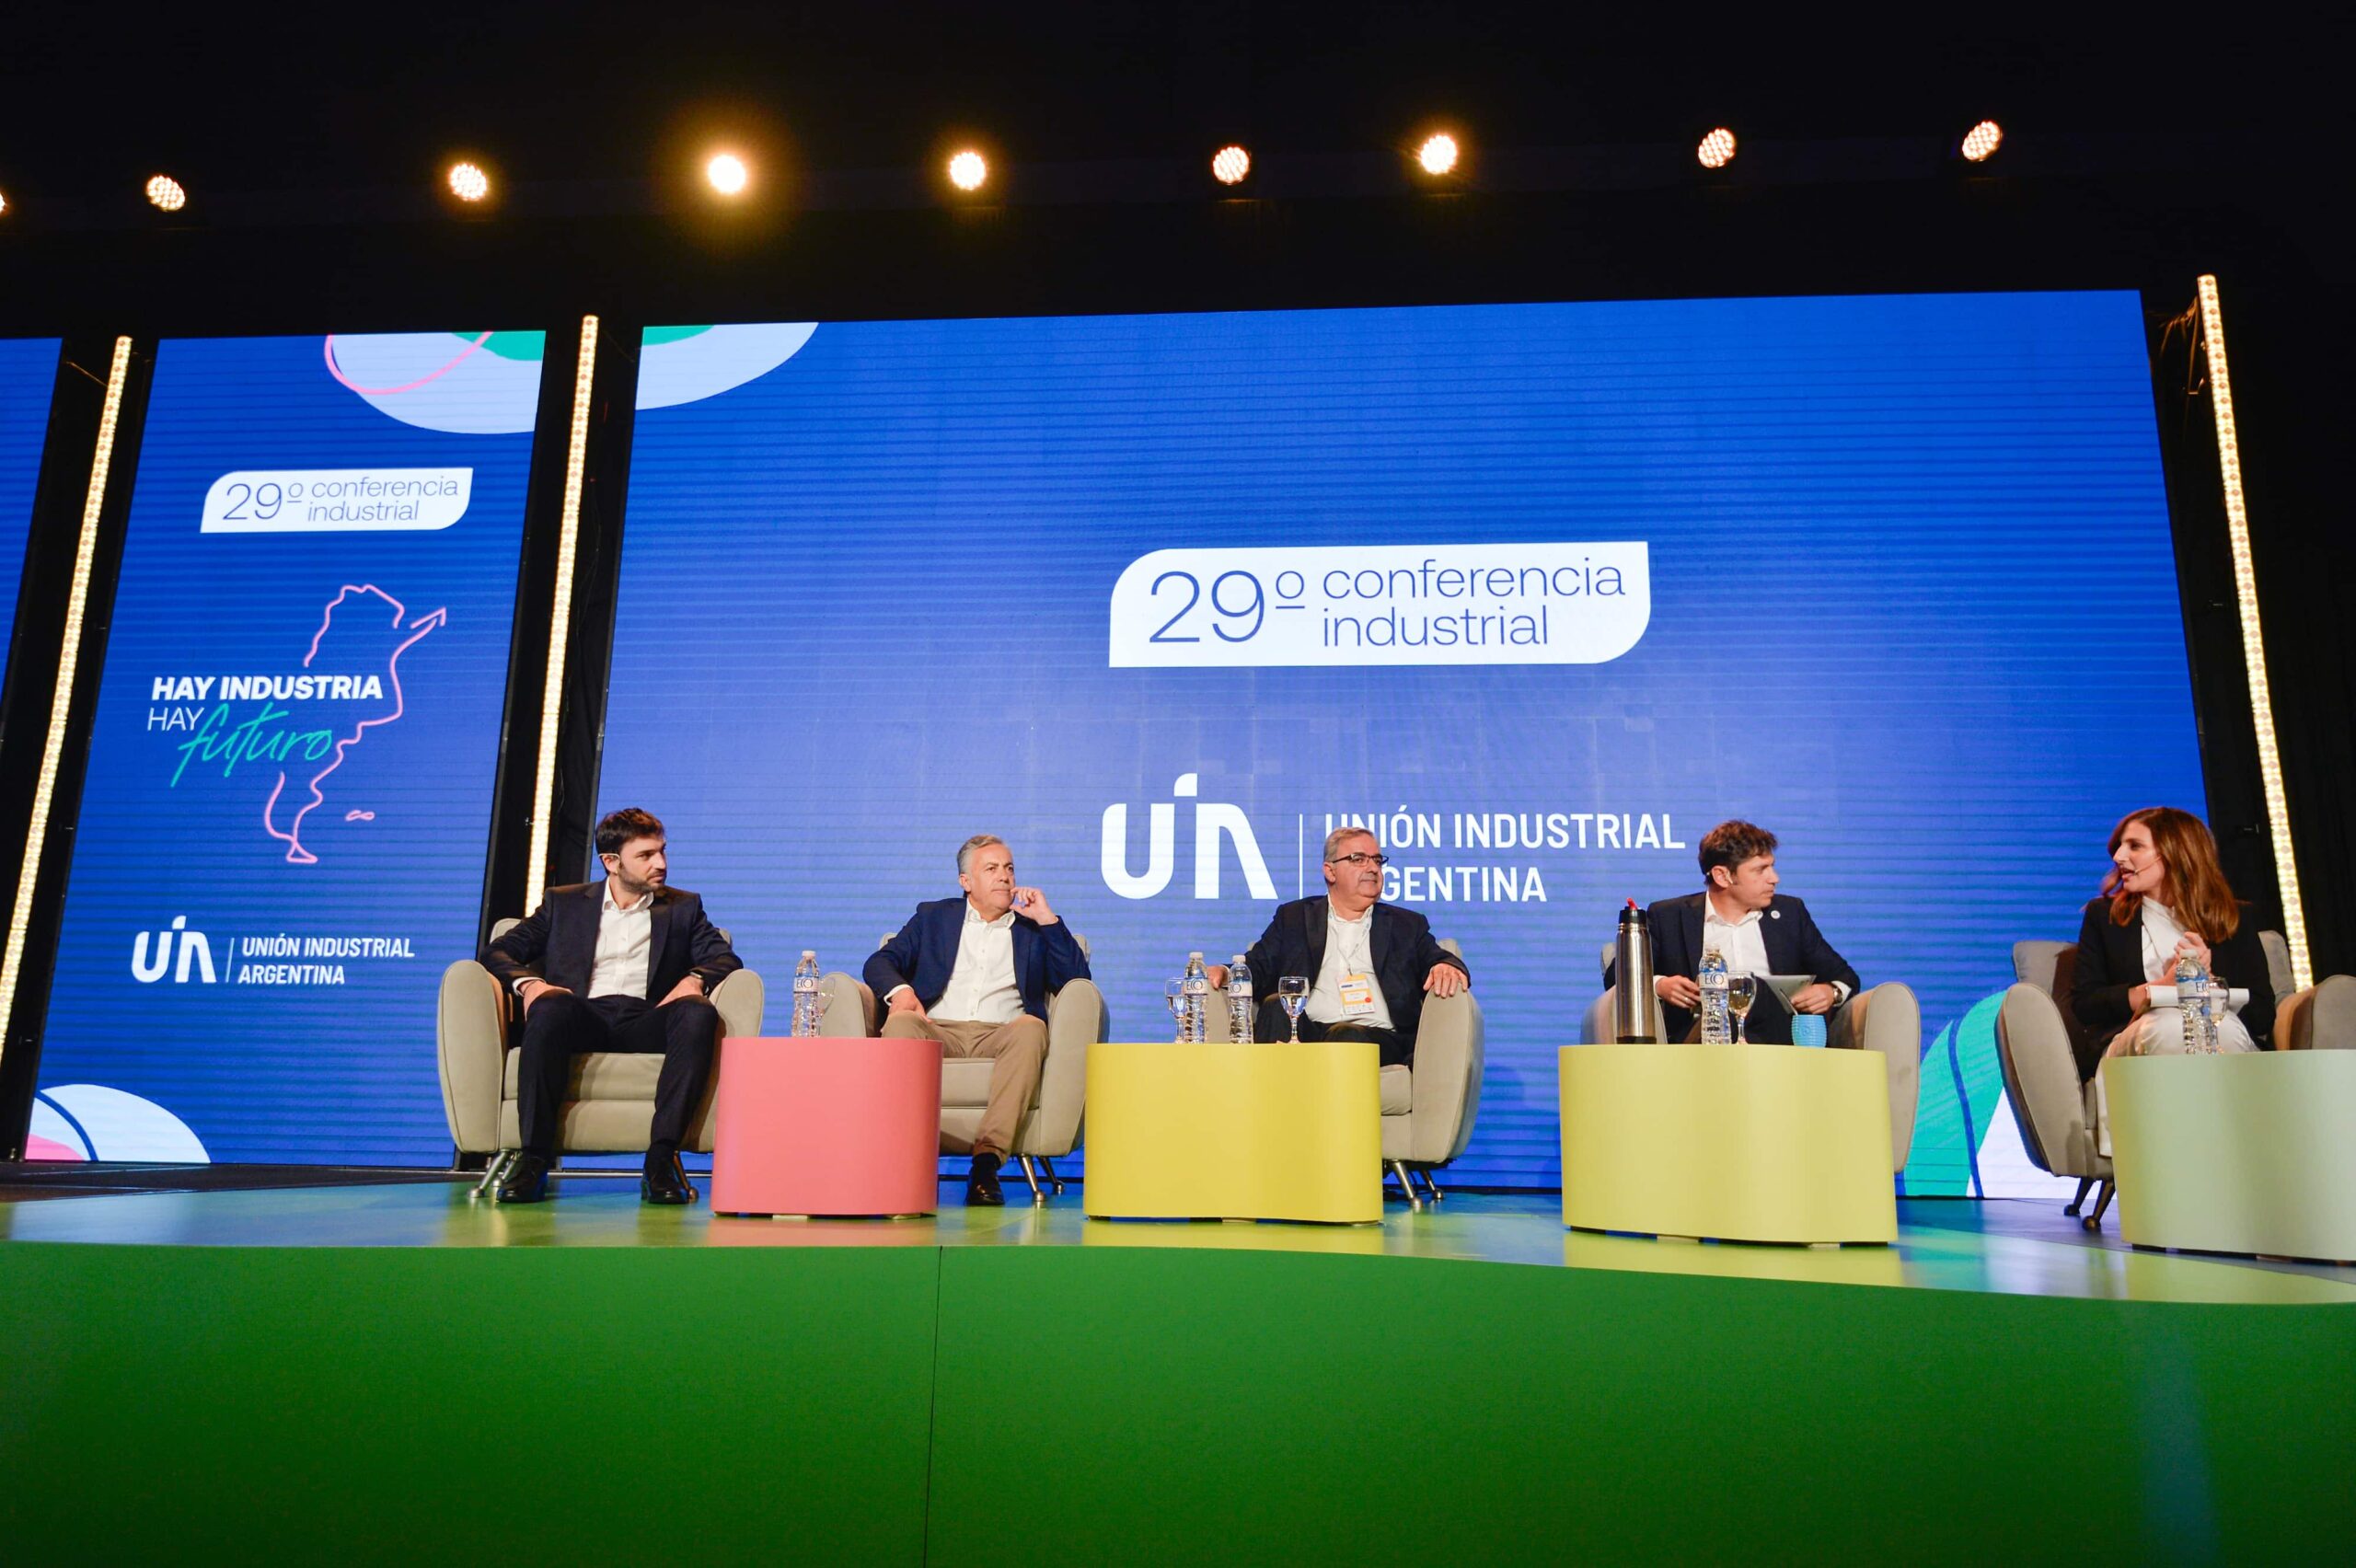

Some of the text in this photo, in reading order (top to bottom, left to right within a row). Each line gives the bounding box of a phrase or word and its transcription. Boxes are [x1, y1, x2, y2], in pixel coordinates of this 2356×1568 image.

[311, 476, 458, 498] conferencia
[307, 500, 420, 522] industrial
[1322, 558, 1626, 599] conferencia
[1323, 604, 1548, 647] industrial
[151, 674, 384, 700] HAY INDUSTRIA
[147, 701, 333, 788] HAY futuro
[1454, 813, 1686, 849] INDUSTRIAL
[1381, 866, 1547, 902] GENTINA
[242, 933, 415, 958] UNIÓN INDUSTRIAL
[237, 964, 345, 985] ARGENTINA
